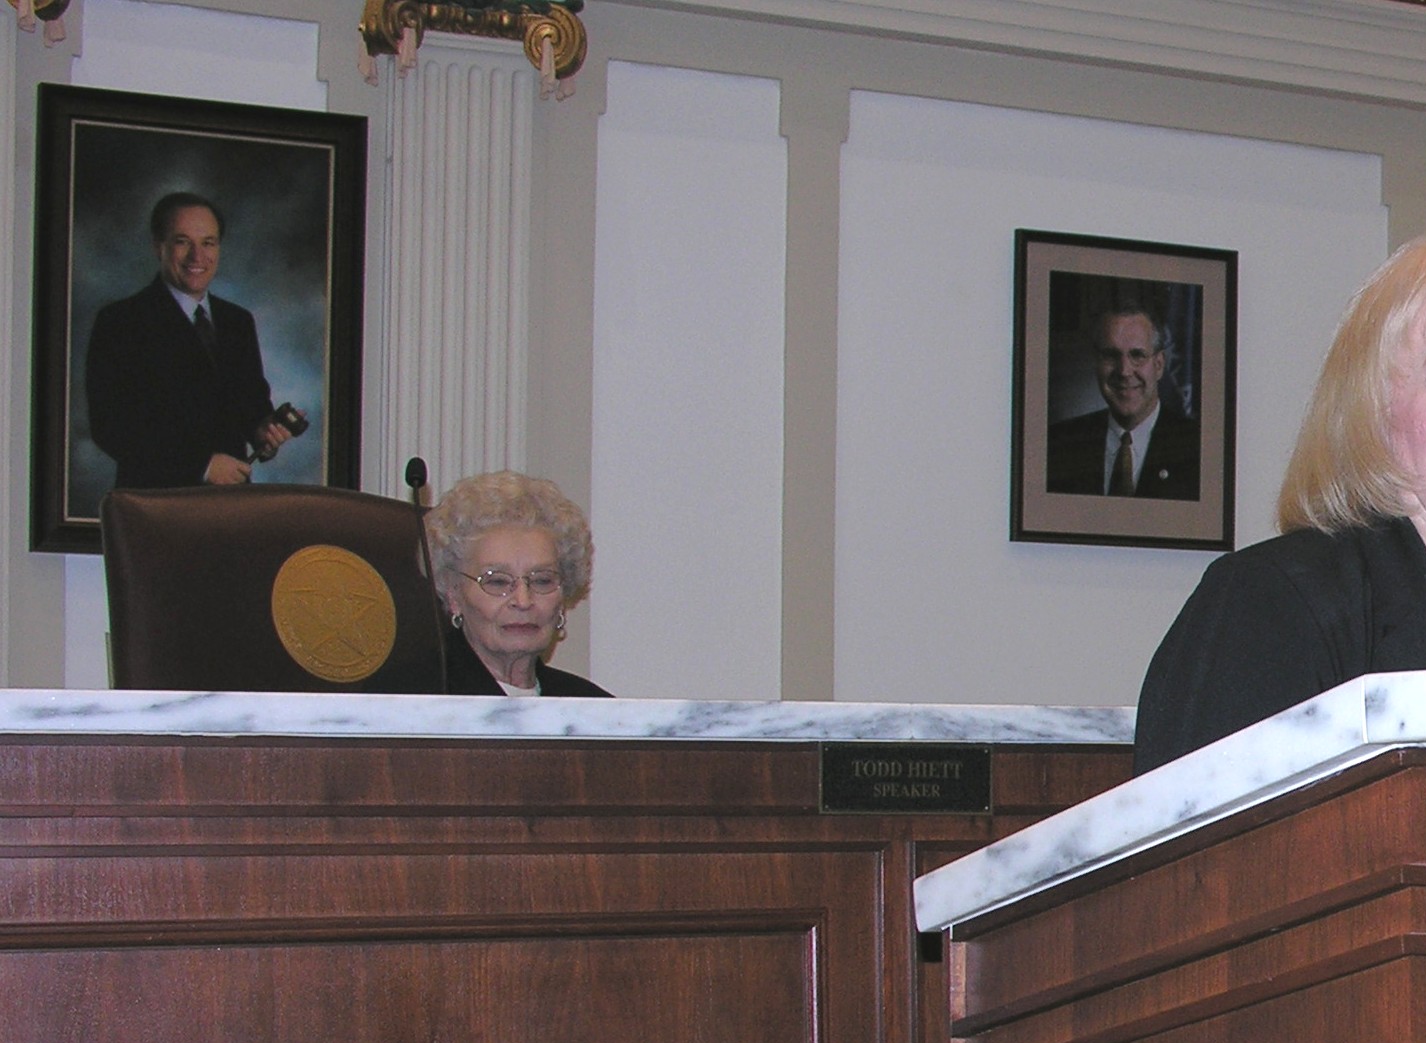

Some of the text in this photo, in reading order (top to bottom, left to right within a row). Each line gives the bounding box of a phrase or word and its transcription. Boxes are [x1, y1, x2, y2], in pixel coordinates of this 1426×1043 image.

[851, 759, 964, 779] TODD HIETT
[873, 783, 940, 798] SPEAKER
